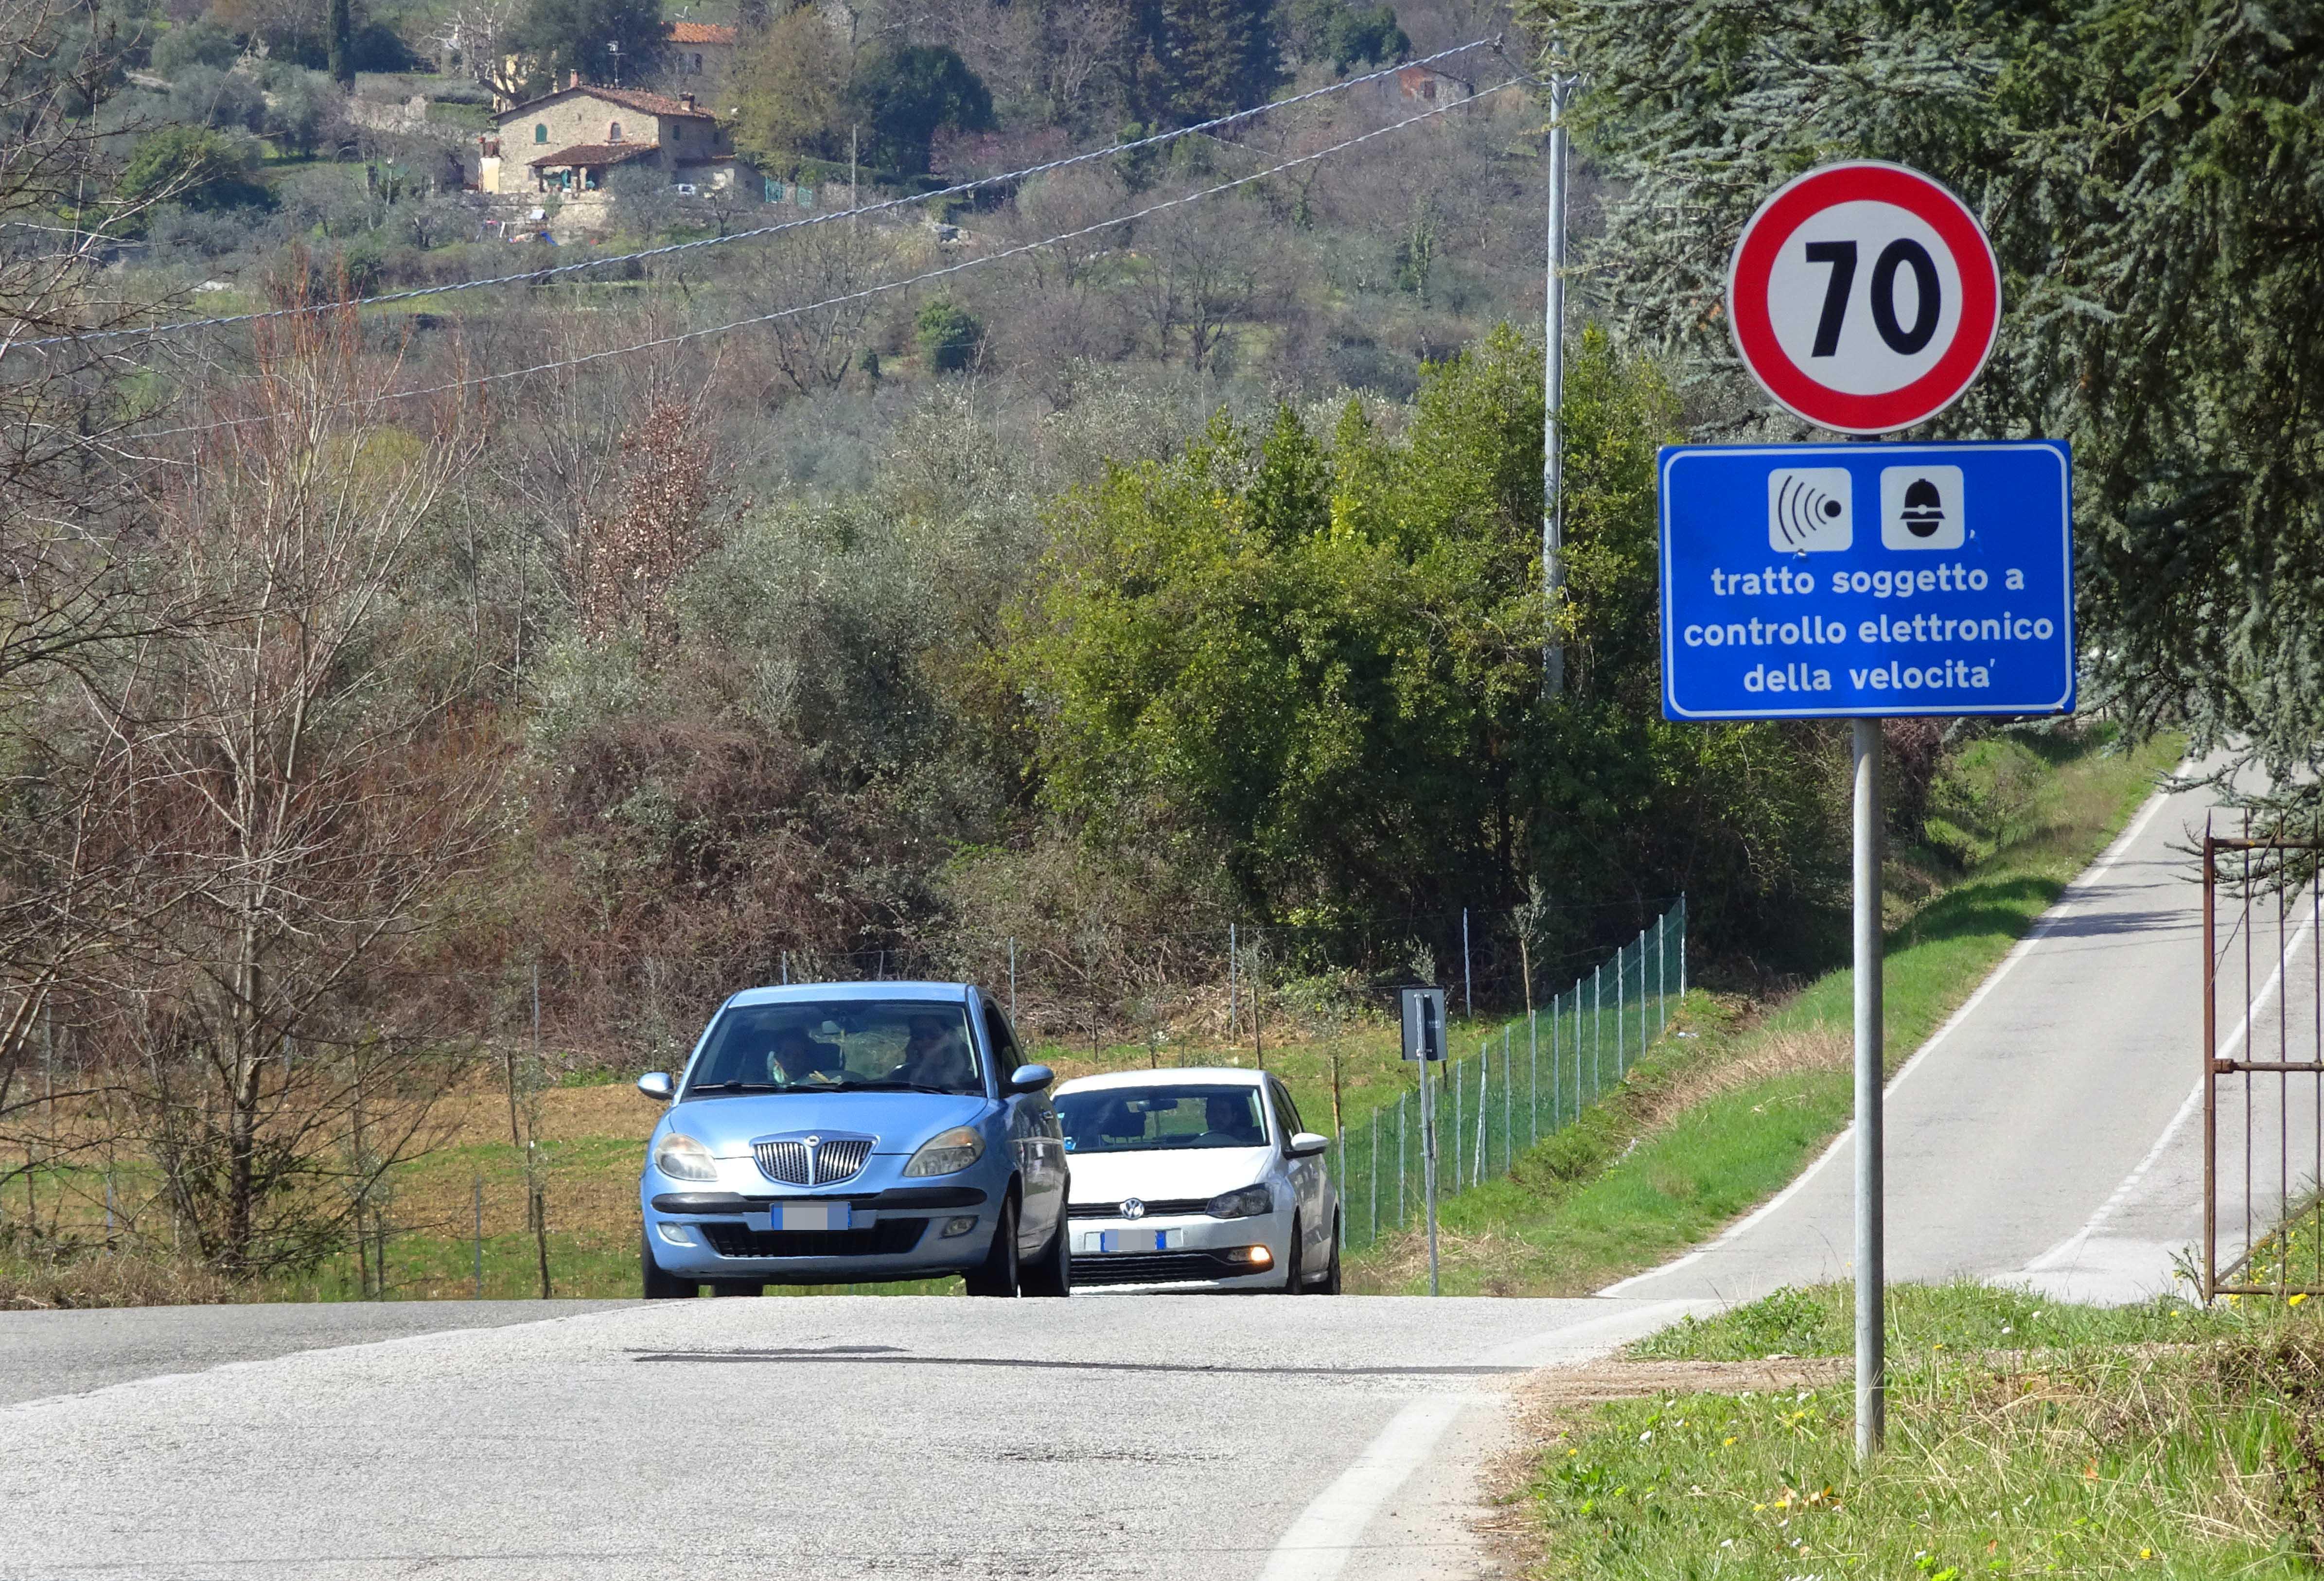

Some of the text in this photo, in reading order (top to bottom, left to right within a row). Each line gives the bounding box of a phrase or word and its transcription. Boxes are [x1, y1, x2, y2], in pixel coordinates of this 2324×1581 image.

[1805, 238, 1941, 357] 70
[1710, 562, 2024, 598] tratto soggetto a
[1684, 612, 2054, 647] controllo elettronico
[1743, 663, 1832, 692] della
